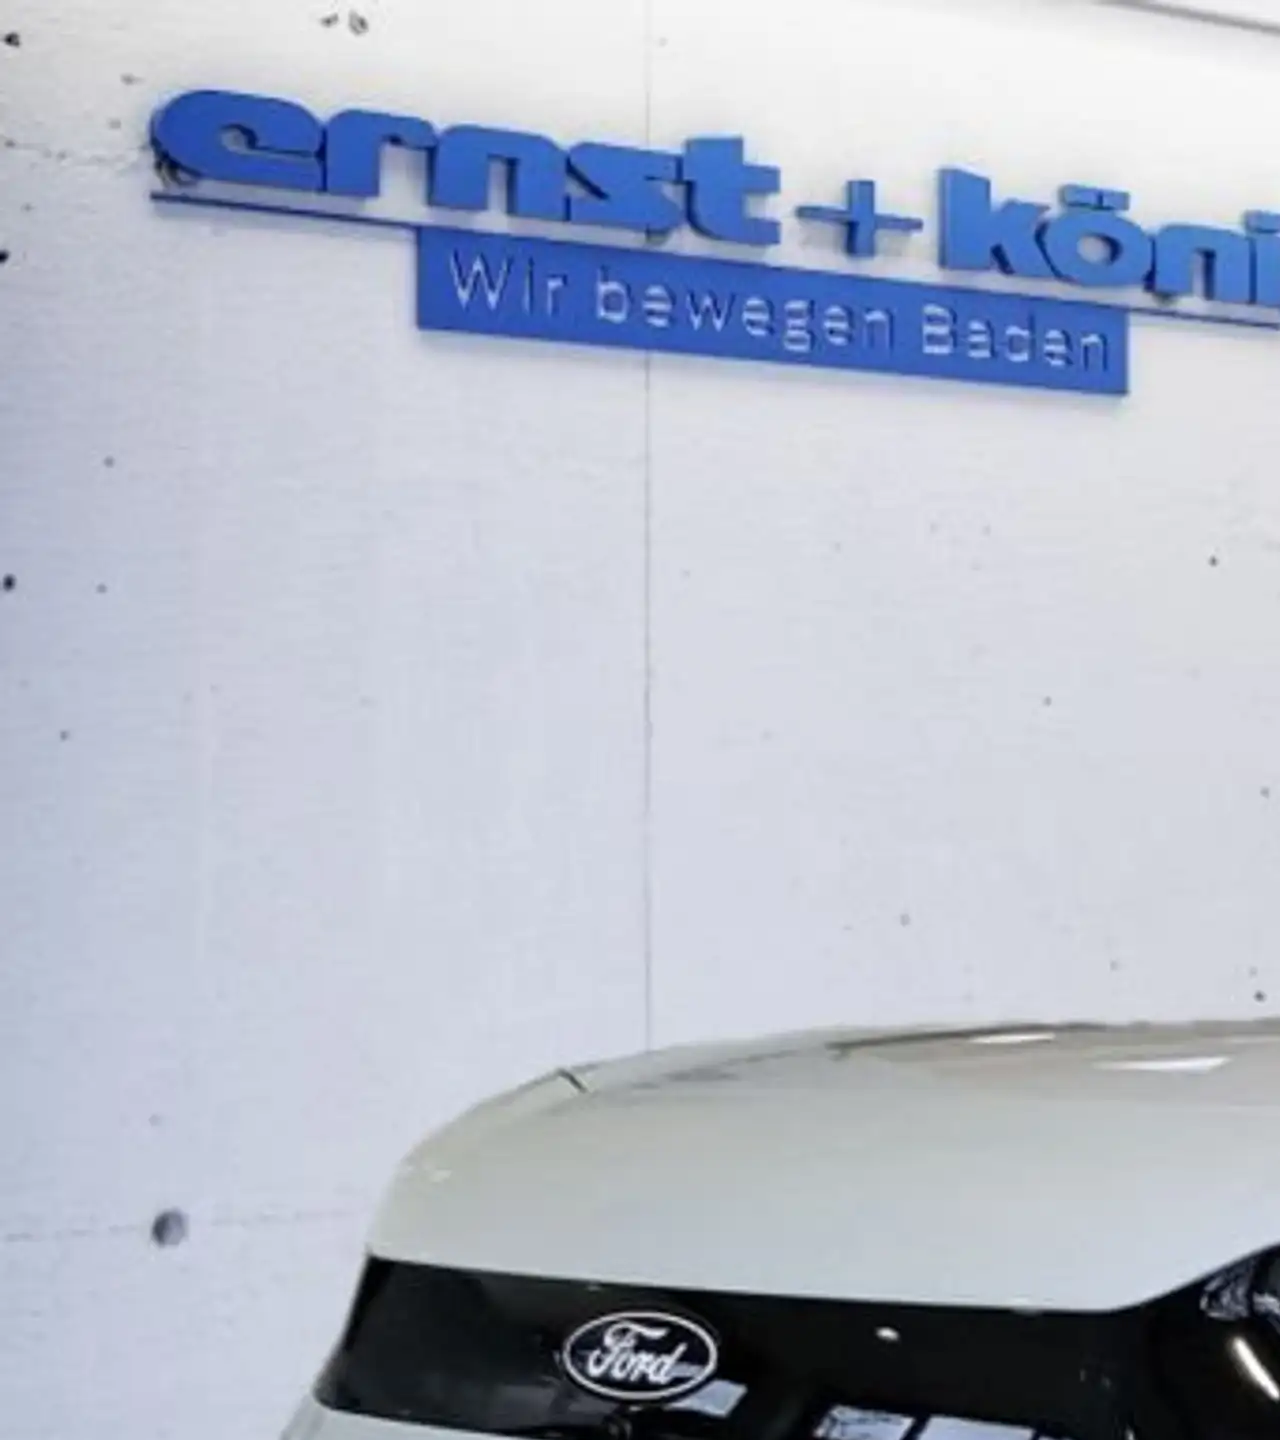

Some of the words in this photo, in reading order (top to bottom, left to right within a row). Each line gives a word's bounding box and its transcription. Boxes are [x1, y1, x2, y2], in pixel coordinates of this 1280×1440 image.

[449, 248, 567, 317] Wir
[596, 264, 895, 353] bewegen
[922, 303, 1109, 372] Baden
[587, 1320, 688, 1384] Ford
